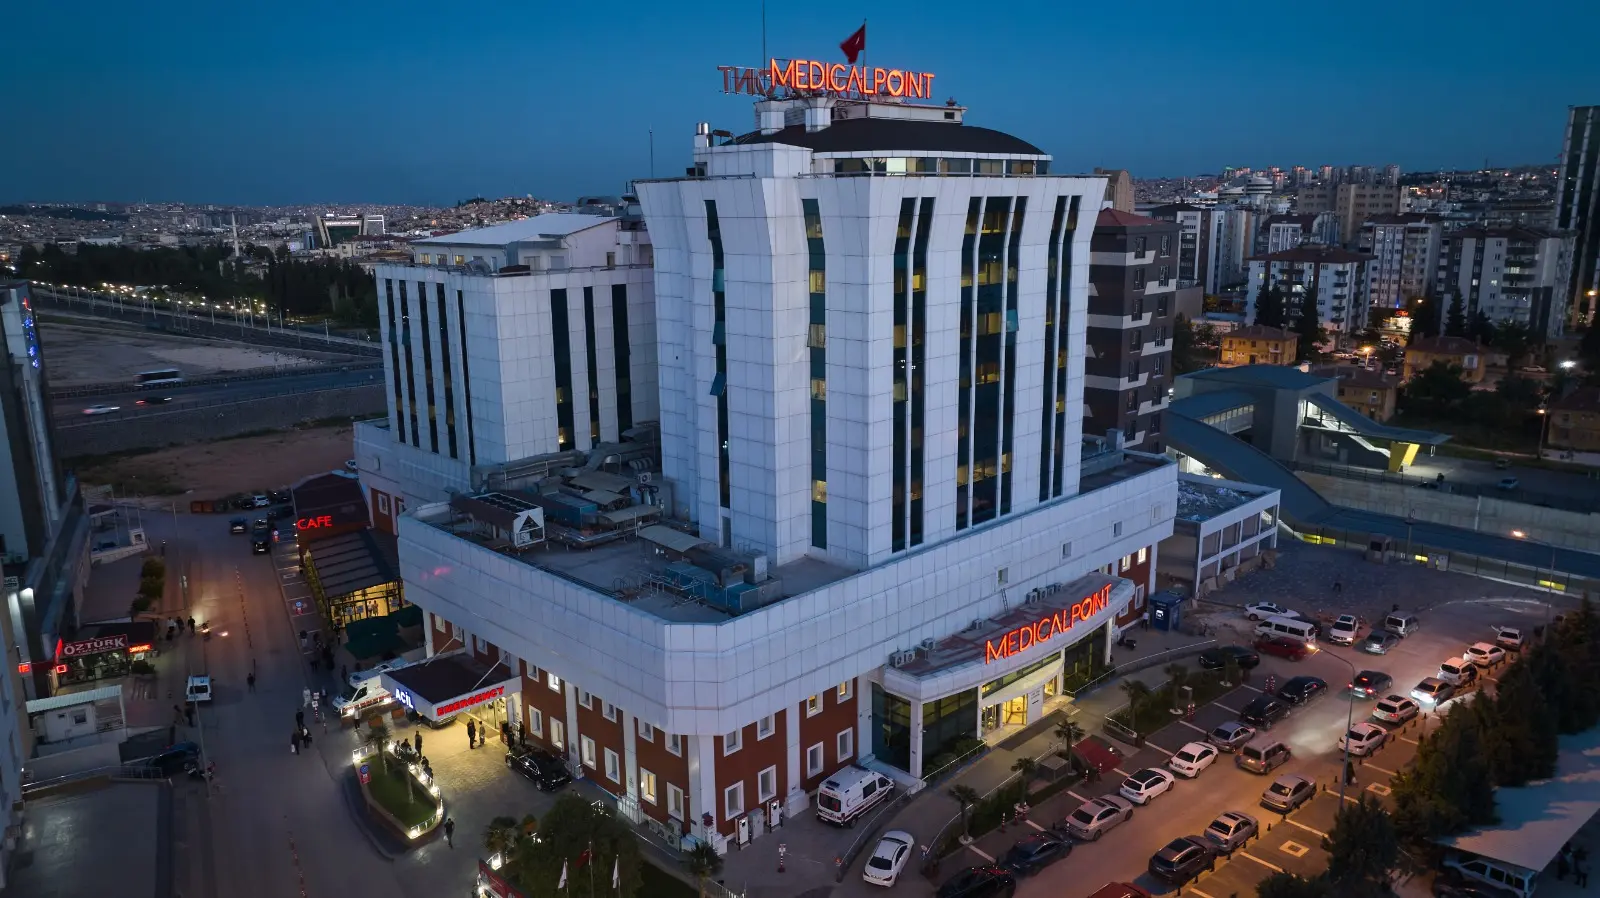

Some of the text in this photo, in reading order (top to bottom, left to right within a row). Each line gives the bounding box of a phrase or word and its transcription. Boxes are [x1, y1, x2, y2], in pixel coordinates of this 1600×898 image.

[769, 58, 935, 99] MEDICALPOINT
[297, 515, 333, 531] CAFE
[985, 583, 1112, 665] MEDICALPOINT
[63, 637, 125, 655] ÖZTÜRK
[436, 685, 505, 717] EMERGENCY
